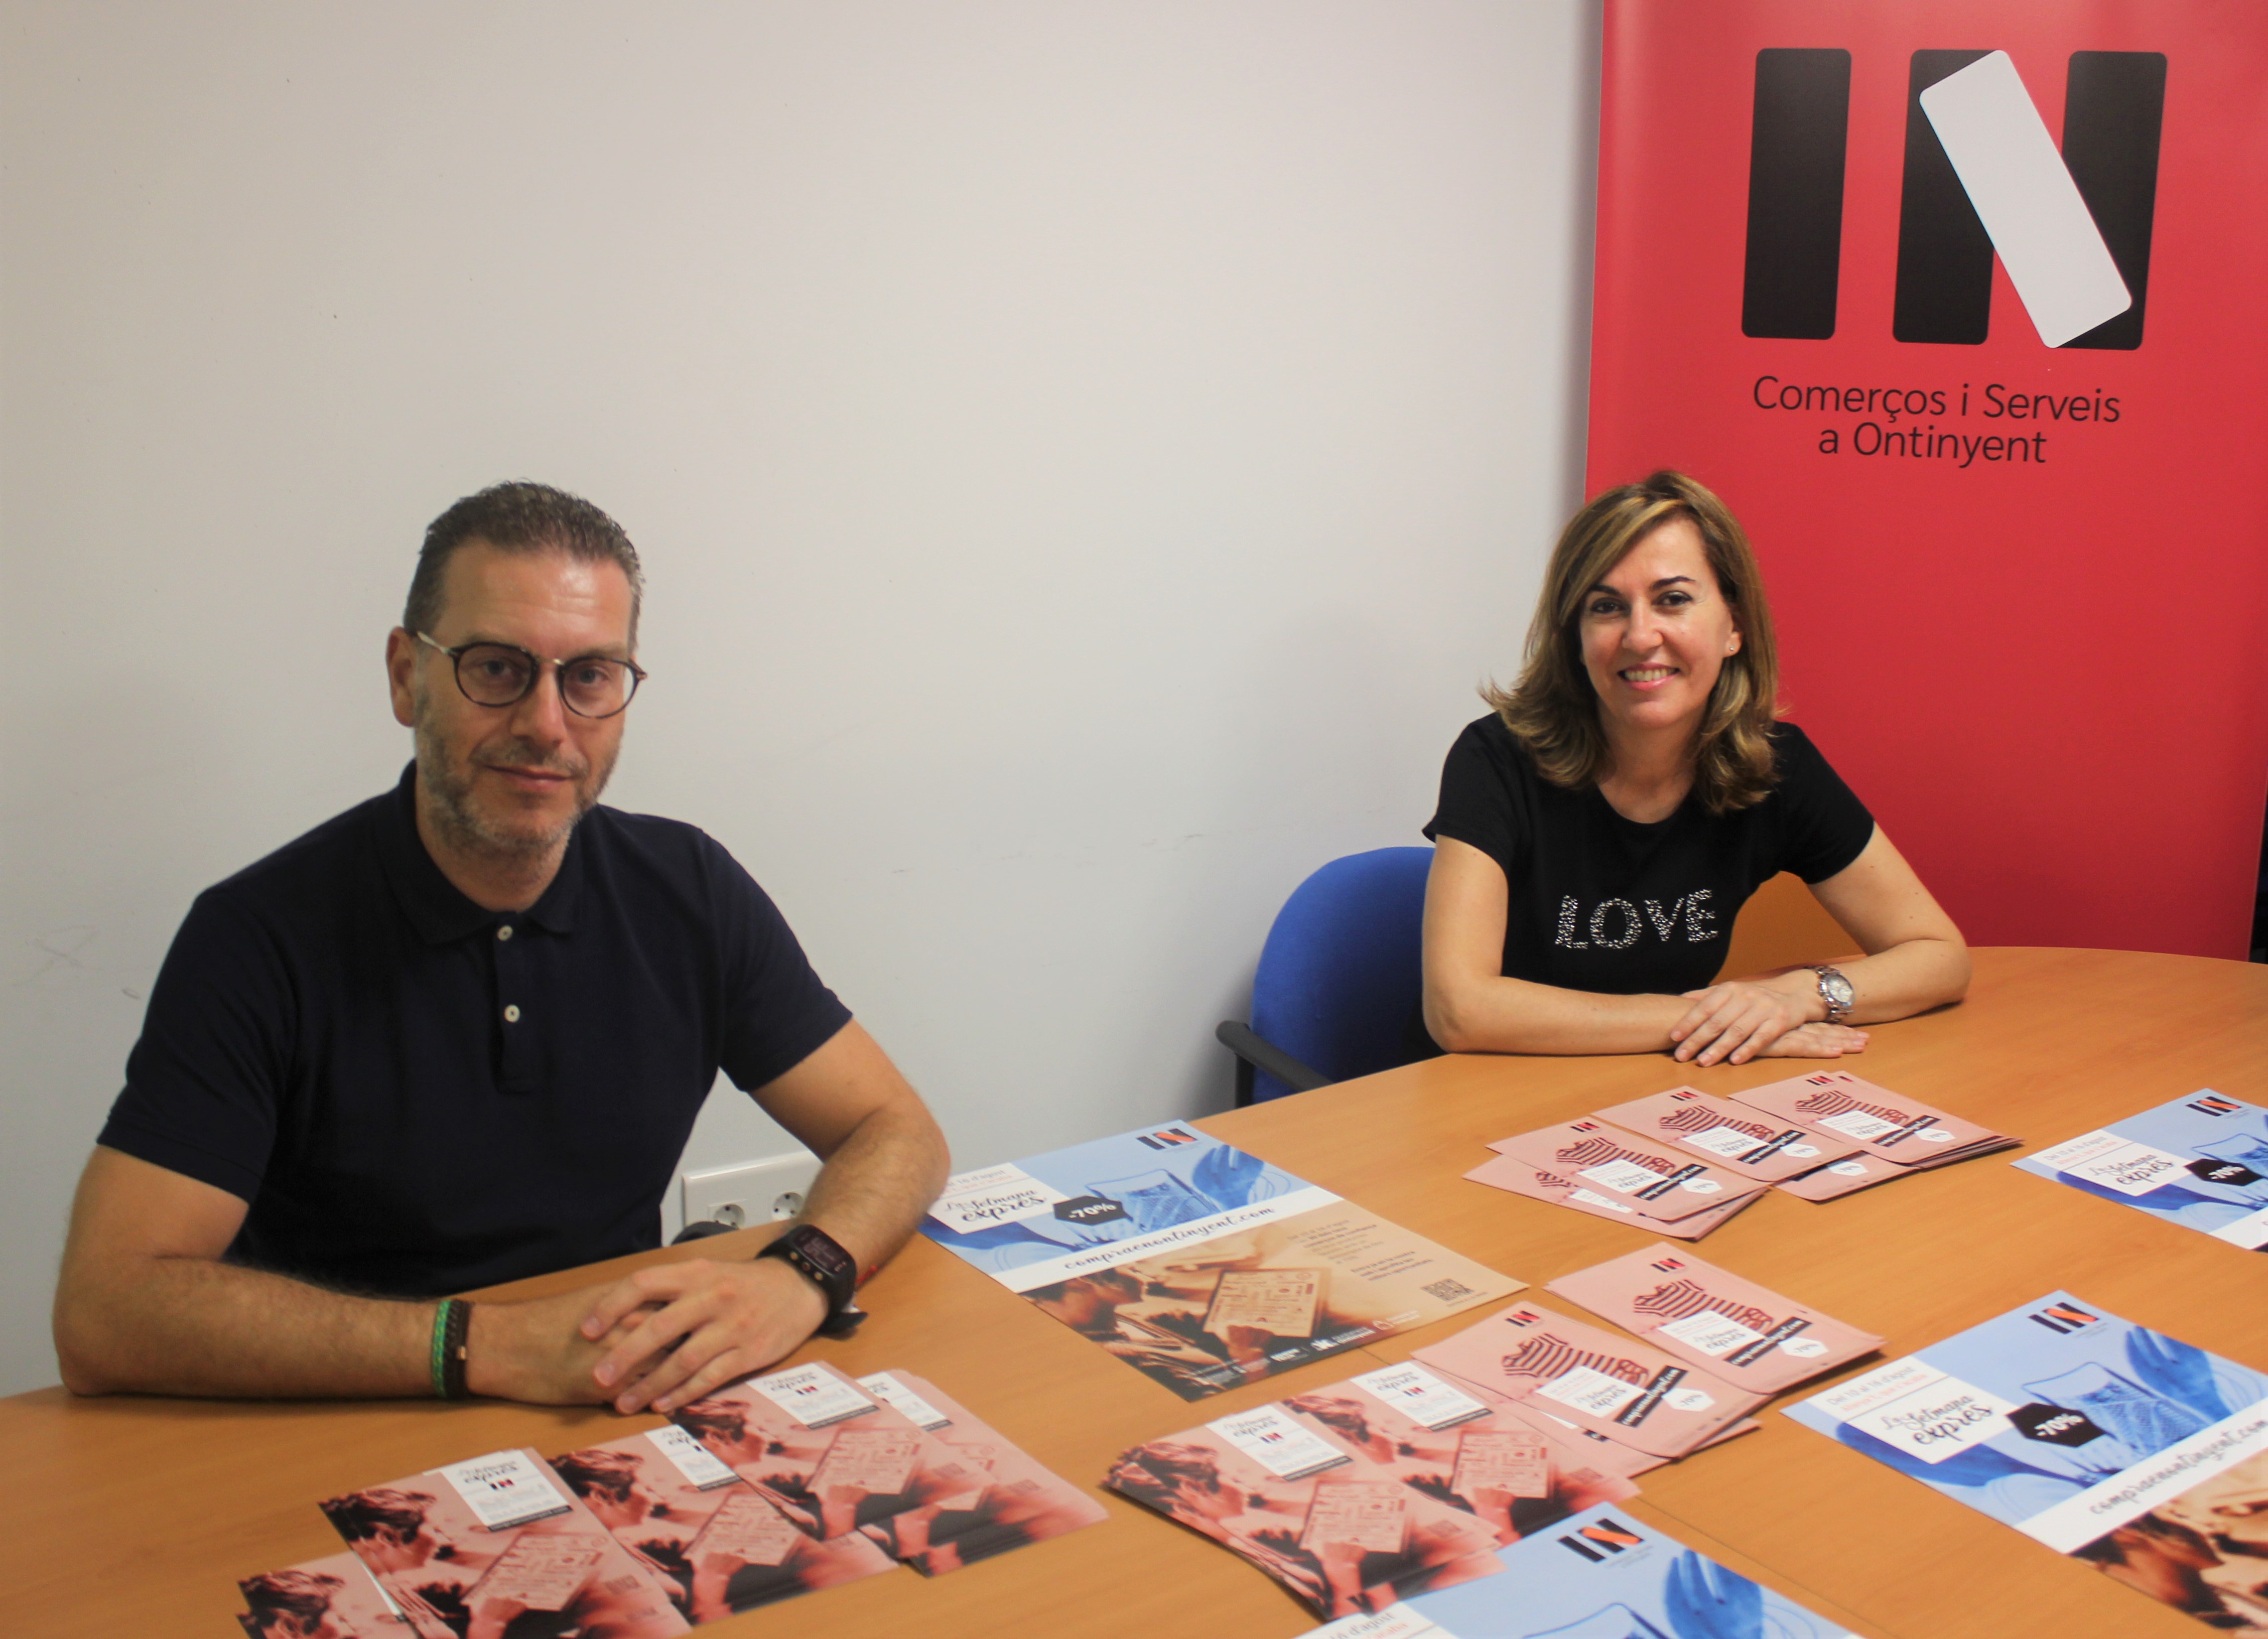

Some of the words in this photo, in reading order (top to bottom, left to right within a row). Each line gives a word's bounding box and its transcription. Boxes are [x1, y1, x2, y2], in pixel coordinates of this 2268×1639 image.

[1741, 48, 2167, 350] IN
[1754, 376, 1946, 423] Comerços
[1961, 383, 1969, 416] i
[1983, 383, 2121, 422] Serveis
[1818, 429, 1839, 454] a
[1854, 421, 2047, 469] Ontinyent
[1555, 889, 1719, 949] LOVE
[1068, 1203, 1117, 1219] -70%
[2034, 1413, 2086, 1436] -70%
[1349, 1612, 1396, 1636] d'agost
